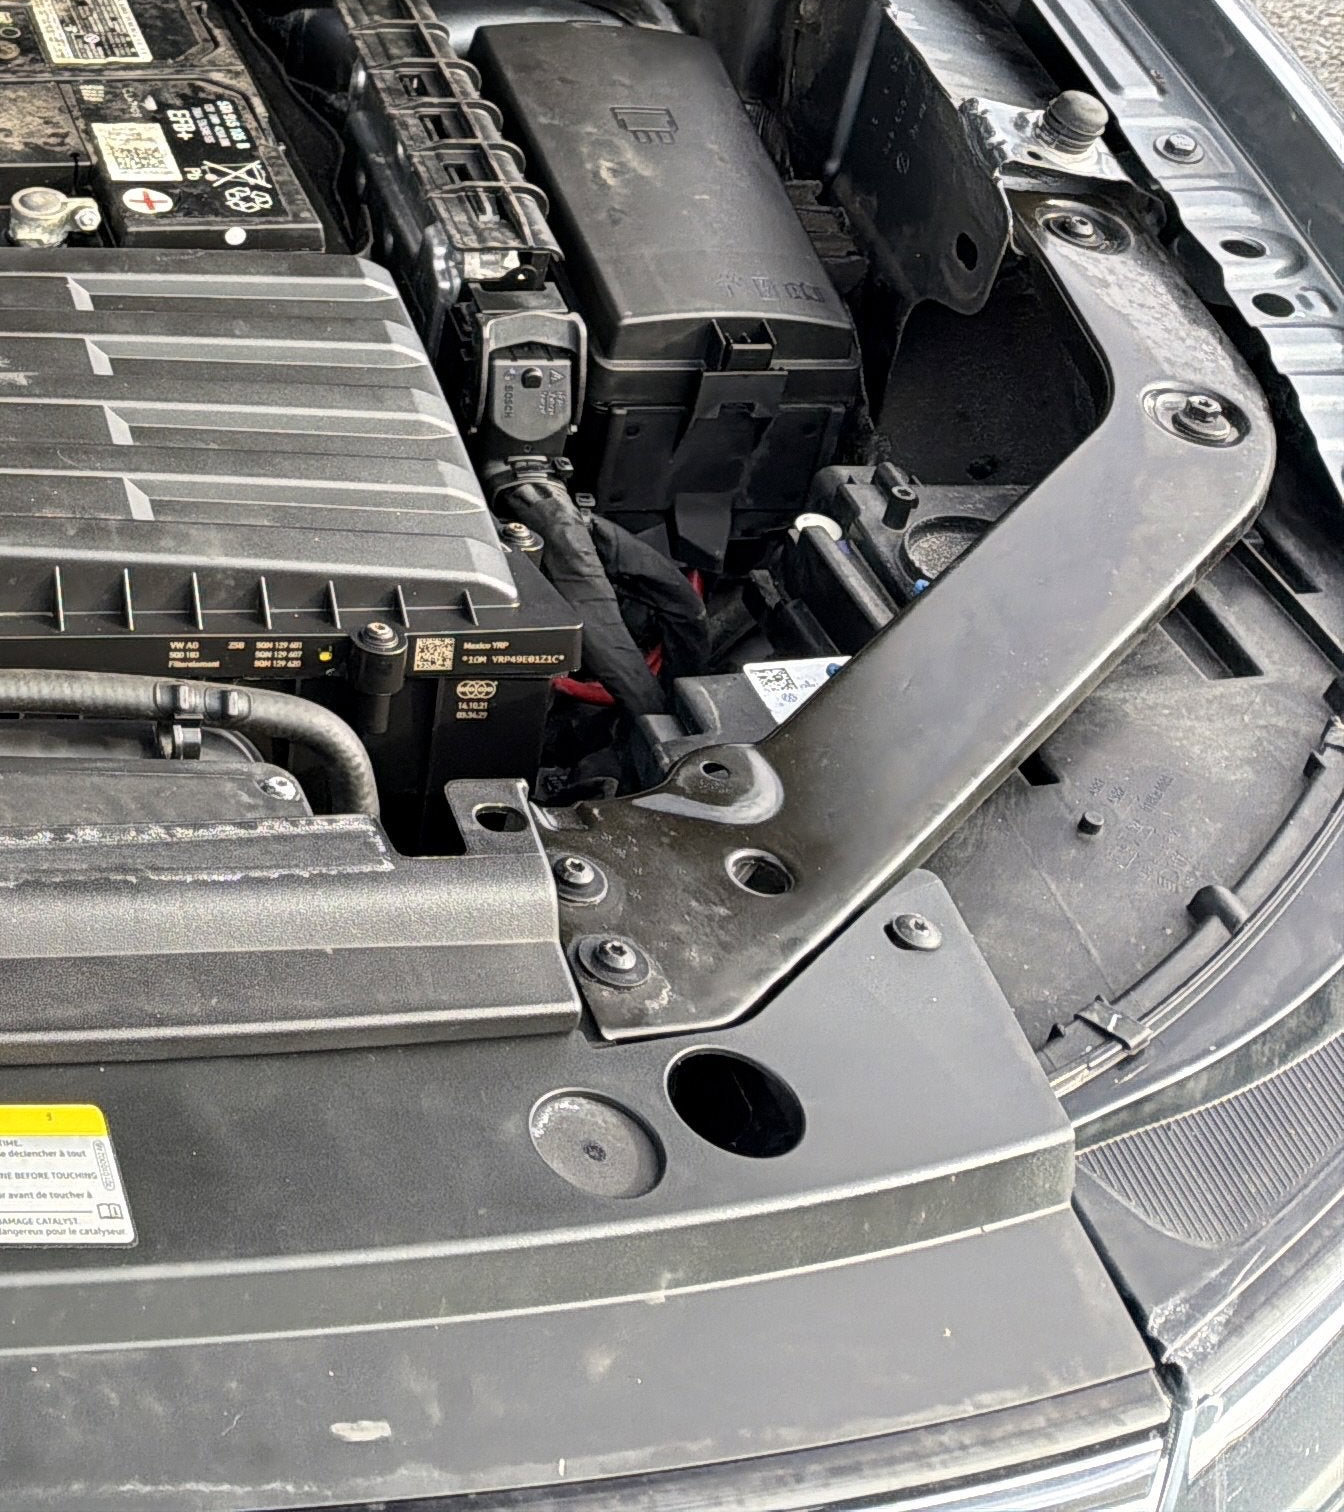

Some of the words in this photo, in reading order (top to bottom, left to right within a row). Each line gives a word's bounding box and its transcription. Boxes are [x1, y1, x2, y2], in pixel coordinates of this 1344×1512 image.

[183, 168, 203, 180] Pb
[504, 385, 514, 418] BOSCH
[463, 642, 492, 650] Mexico
[492, 642, 510, 650] YRP
[8, 1150, 56, 1158] déclencher
[14, 1172, 49, 1180] BEFORE
[46, 1228, 66, 1236] pour
[78, 1228, 127, 1236] catalyseur.
